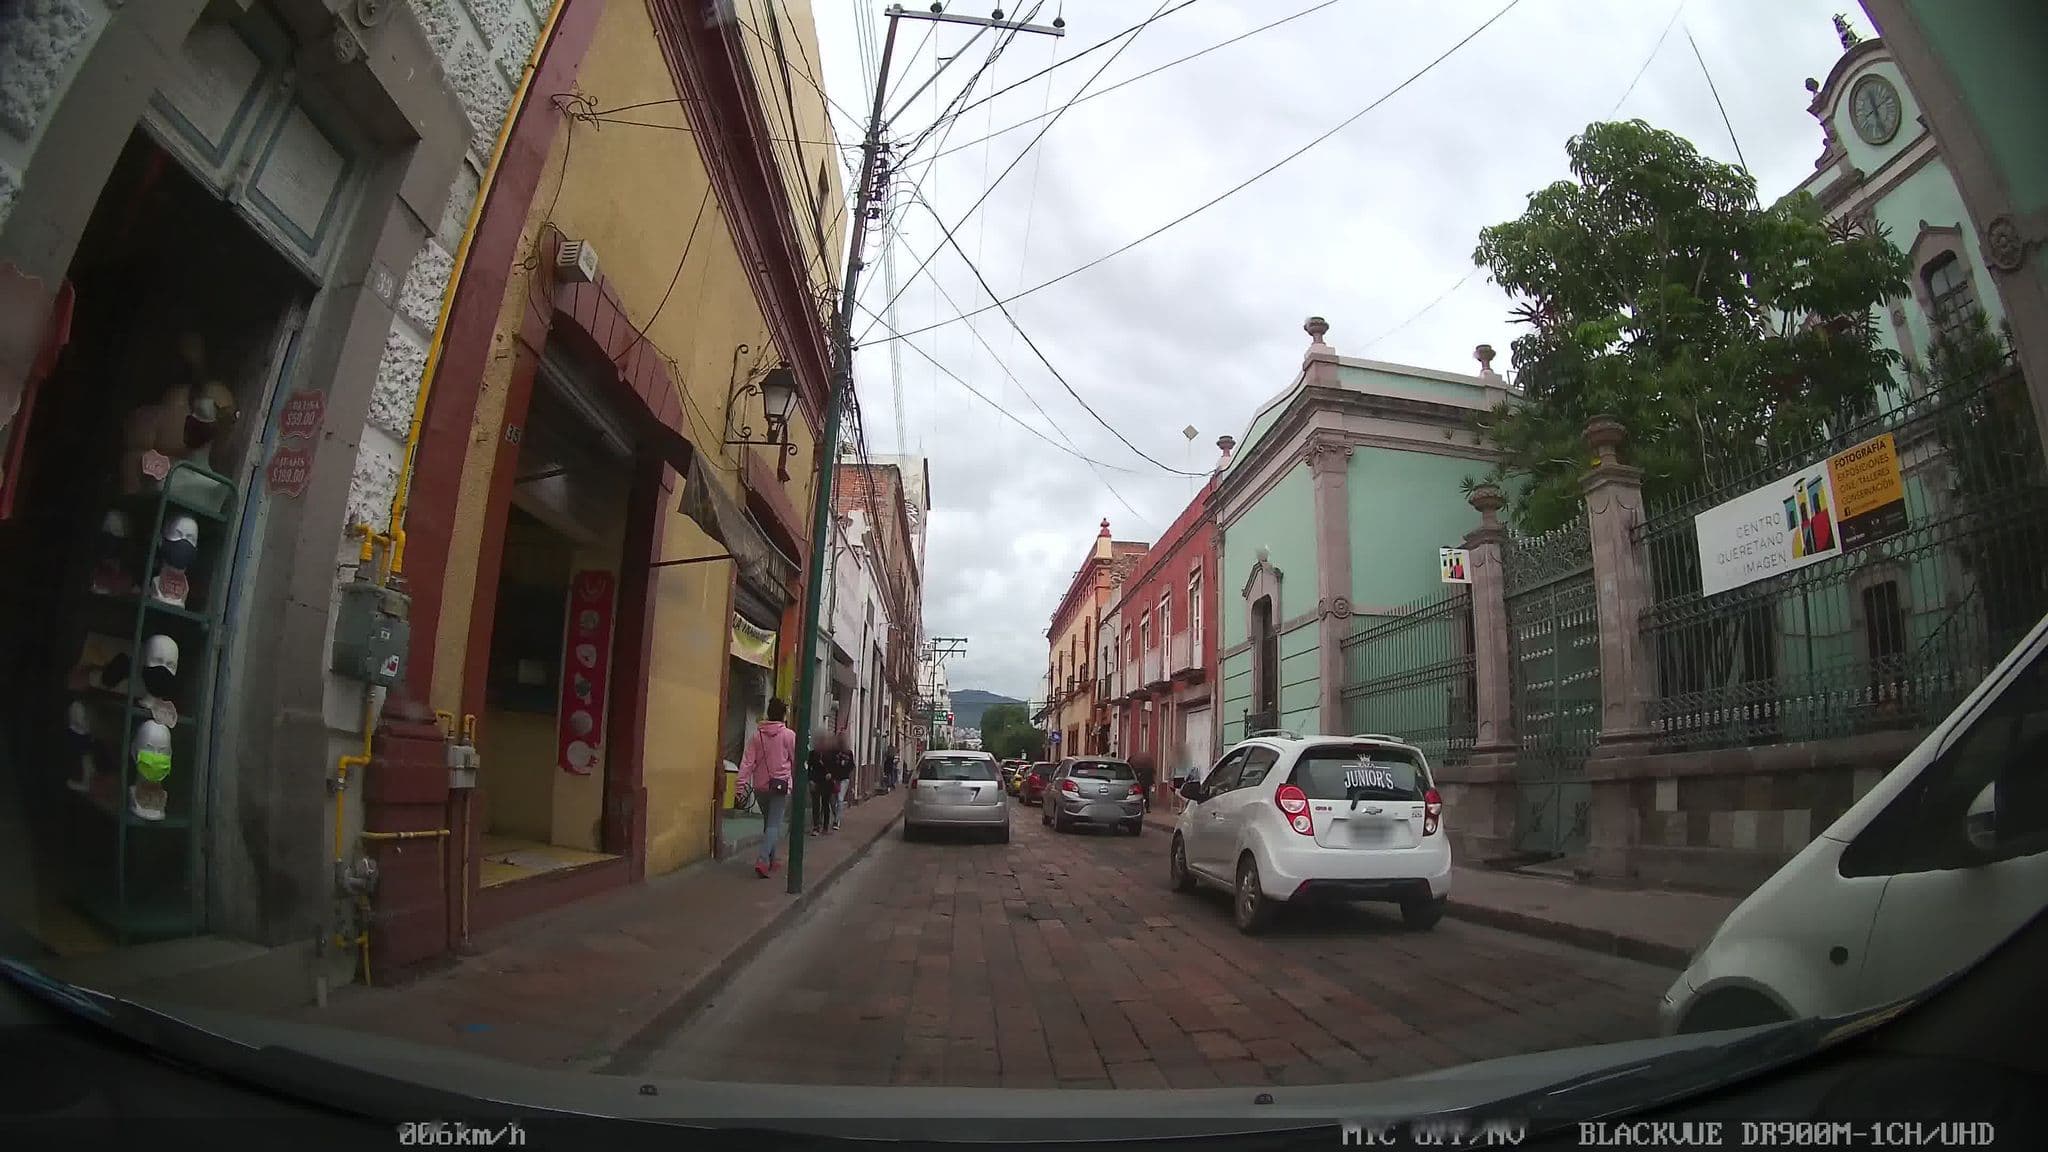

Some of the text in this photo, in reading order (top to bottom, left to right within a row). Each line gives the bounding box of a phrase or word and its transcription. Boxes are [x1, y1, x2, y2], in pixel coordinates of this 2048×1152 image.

[1736, 512, 1781, 538] CENTRO
[1718, 531, 1784, 565] QUERETANO
[1743, 551, 1787, 576] IMAGEN
[1344, 769, 1394, 790] JUNIOR'S
